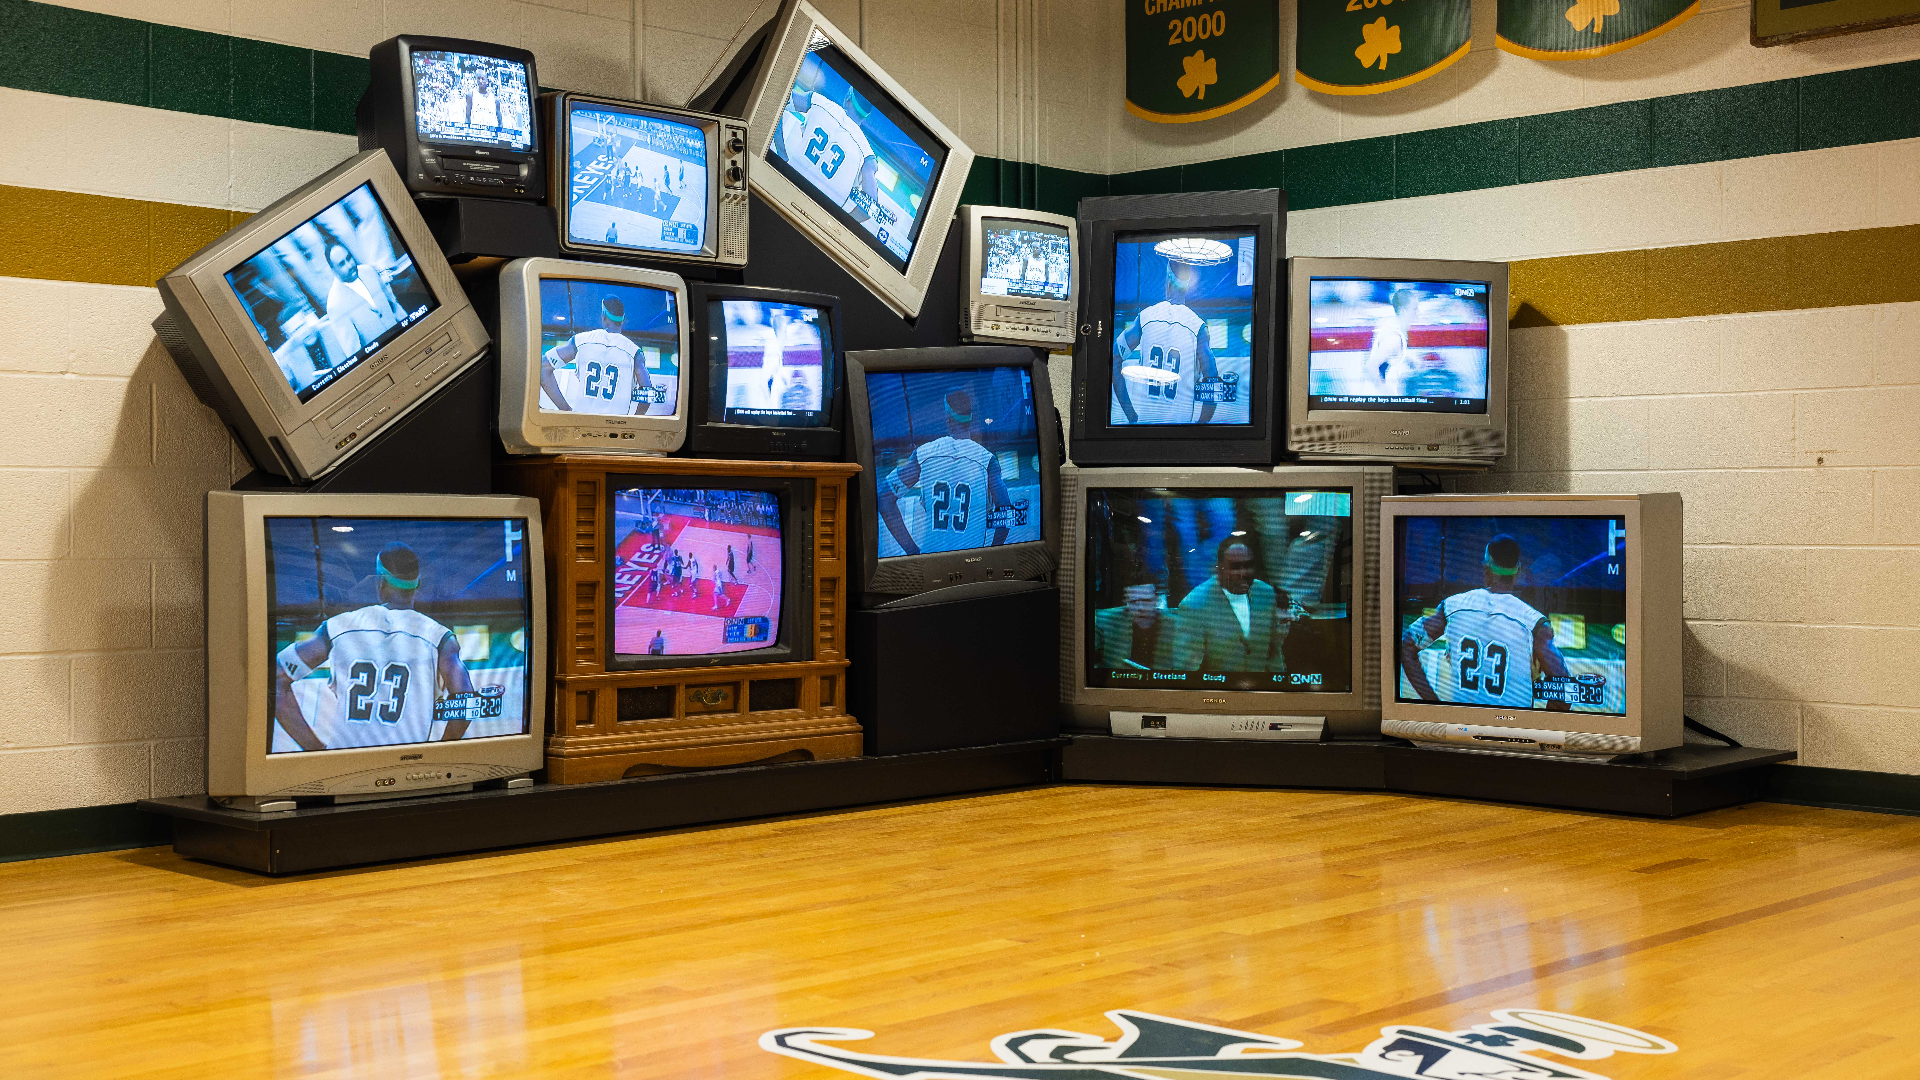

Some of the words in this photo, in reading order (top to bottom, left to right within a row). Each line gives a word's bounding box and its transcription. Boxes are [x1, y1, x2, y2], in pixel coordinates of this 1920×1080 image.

[1169, 10, 1226, 45] 2000
[804, 127, 846, 180] 23
[337, 356, 358, 373] Cleveland
[364, 342, 379, 354] Cloudy
[585, 360, 620, 400] 23
[932, 480, 972, 533] 23
[1112, 671, 1142, 680] Currently
[1153, 672, 1186, 680] Cleveland
[1203, 674, 1226, 682] Cloudy
[1458, 635, 1509, 698] 23
[347, 659, 411, 726] 23
[1543, 682, 1563, 690] SVSM
[1580, 686, 1602, 702] 2:20
[444, 700, 466, 708] SVSM
[444, 710, 459, 718] OAK
[481, 698, 500, 715] 2:20
